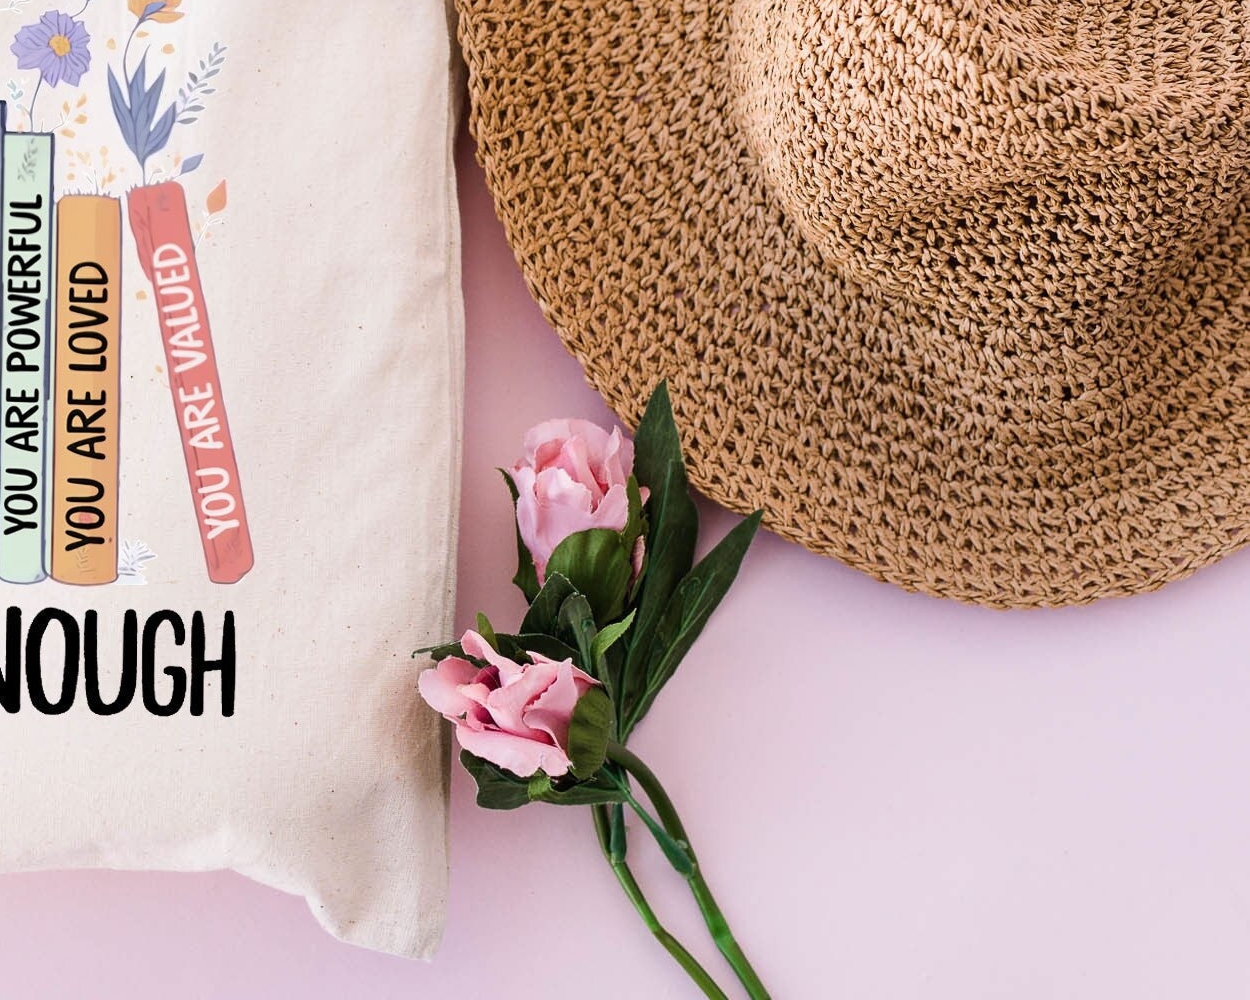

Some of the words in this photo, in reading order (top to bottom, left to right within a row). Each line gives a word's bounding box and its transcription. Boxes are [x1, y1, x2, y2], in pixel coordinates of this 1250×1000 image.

[6, 194, 43, 372] POWERFUL
[68, 260, 109, 372] LOVED
[152, 242, 208, 373] VALUED
[5, 387, 40, 453] ARE
[66, 388, 107, 461] ARE
[178, 381, 224, 450] ARE
[3, 467, 39, 535] YOU
[65, 476, 106, 552] YOU
[200, 466, 240, 541] YOU
